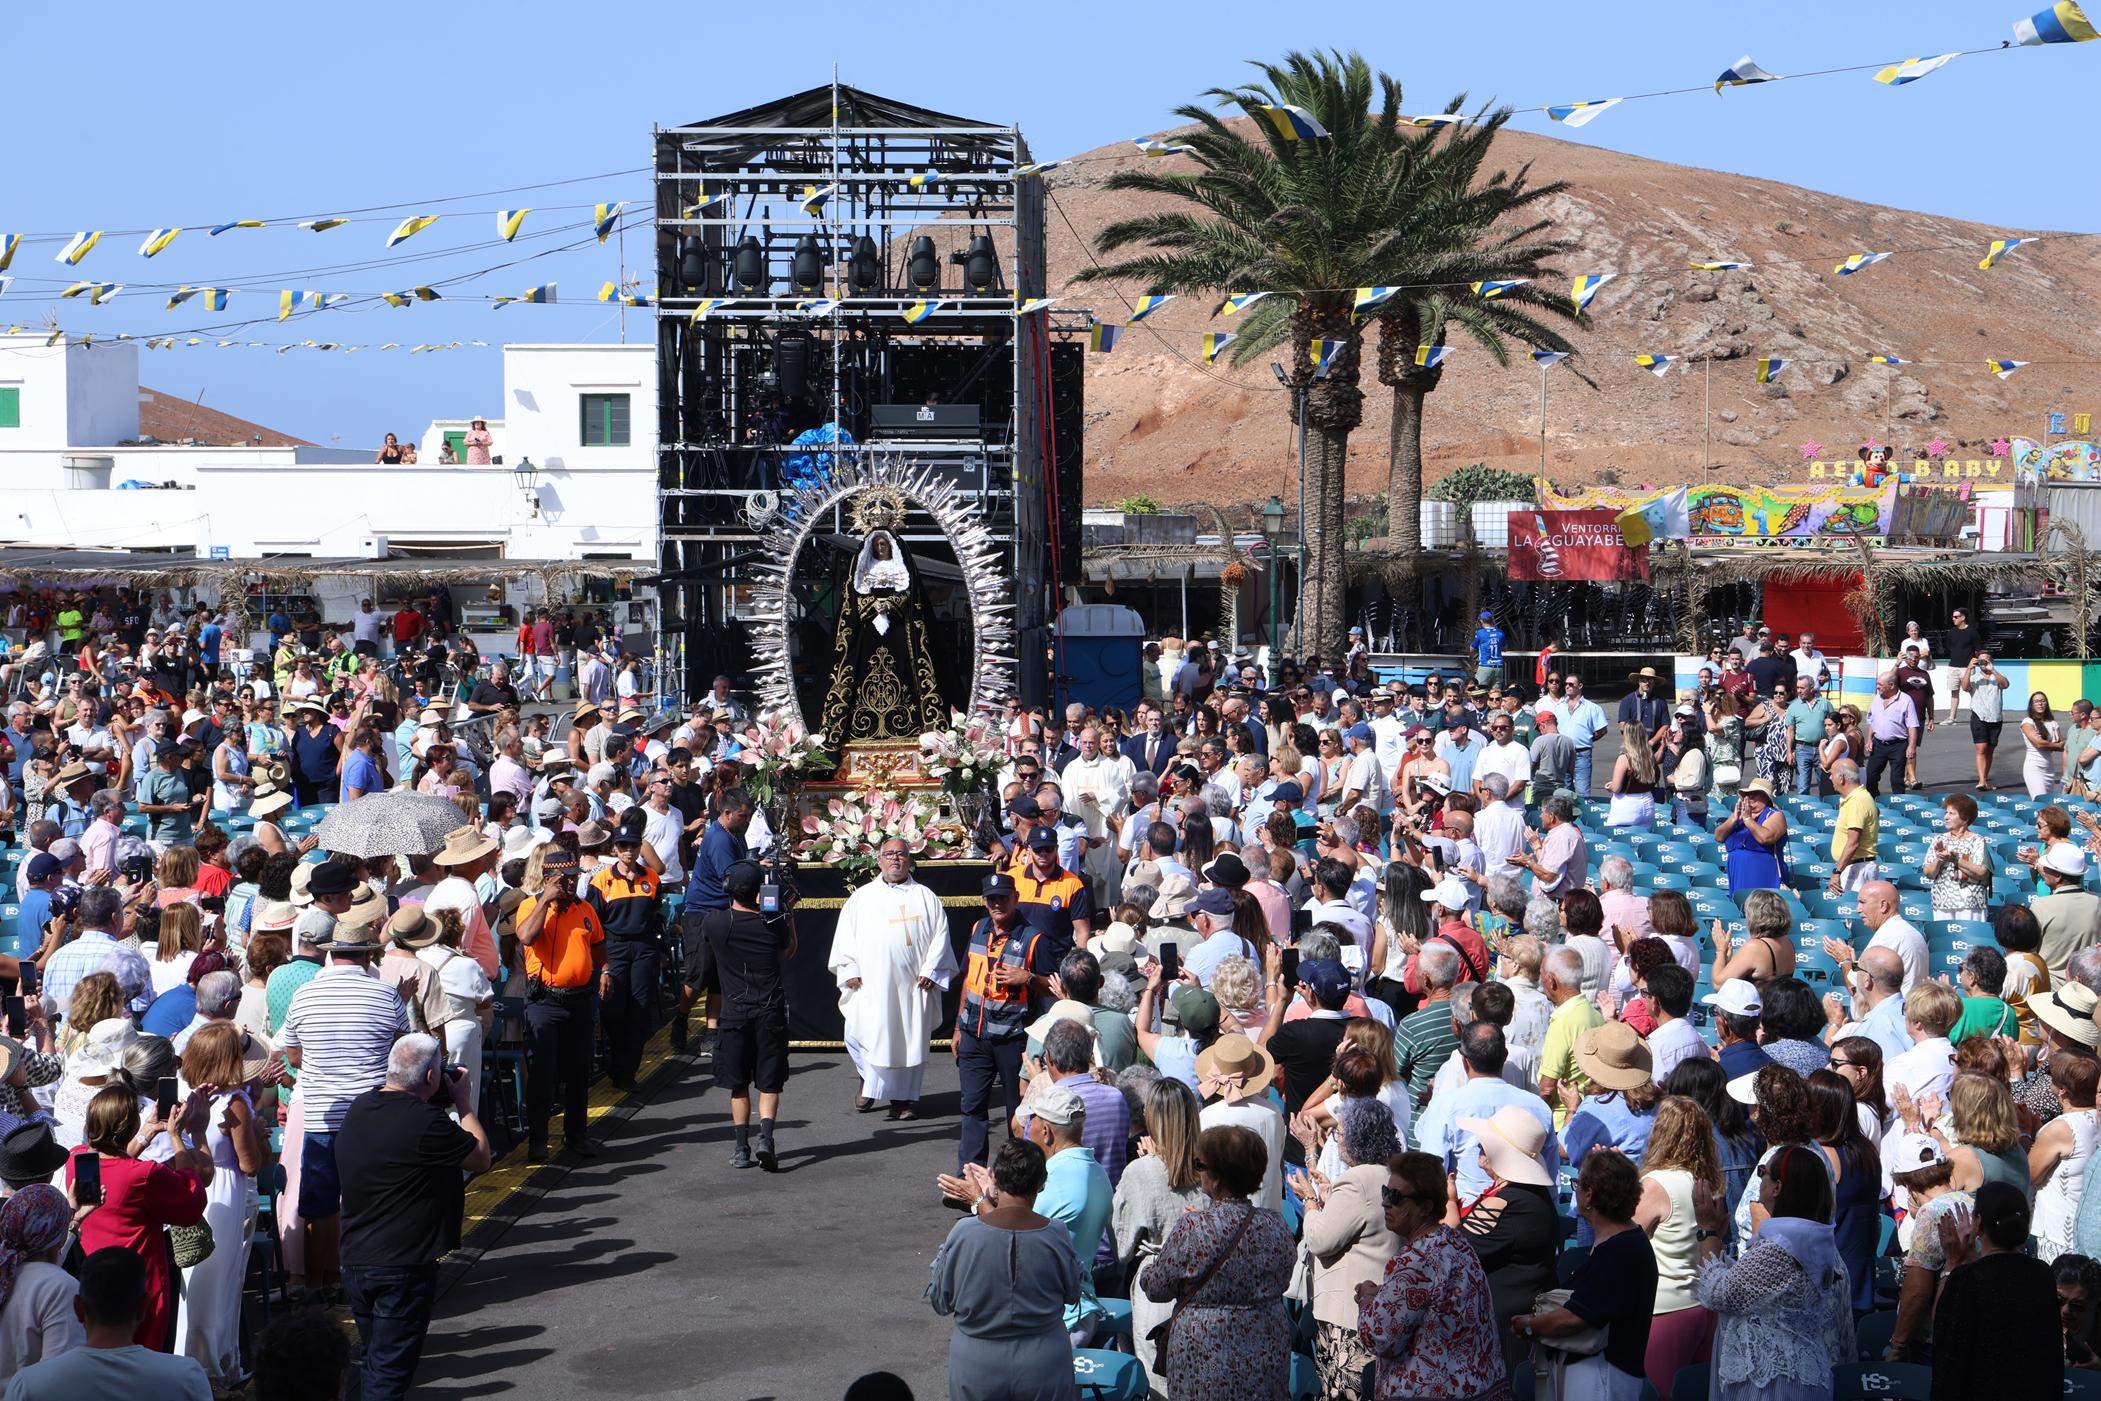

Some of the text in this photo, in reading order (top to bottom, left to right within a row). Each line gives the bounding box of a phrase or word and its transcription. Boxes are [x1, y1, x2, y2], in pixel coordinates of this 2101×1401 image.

[1916, 460, 2001, 478] BABY
[1561, 522, 1621, 533] VENTORRI
[1514, 534, 1624, 547] LA GUAYABE
